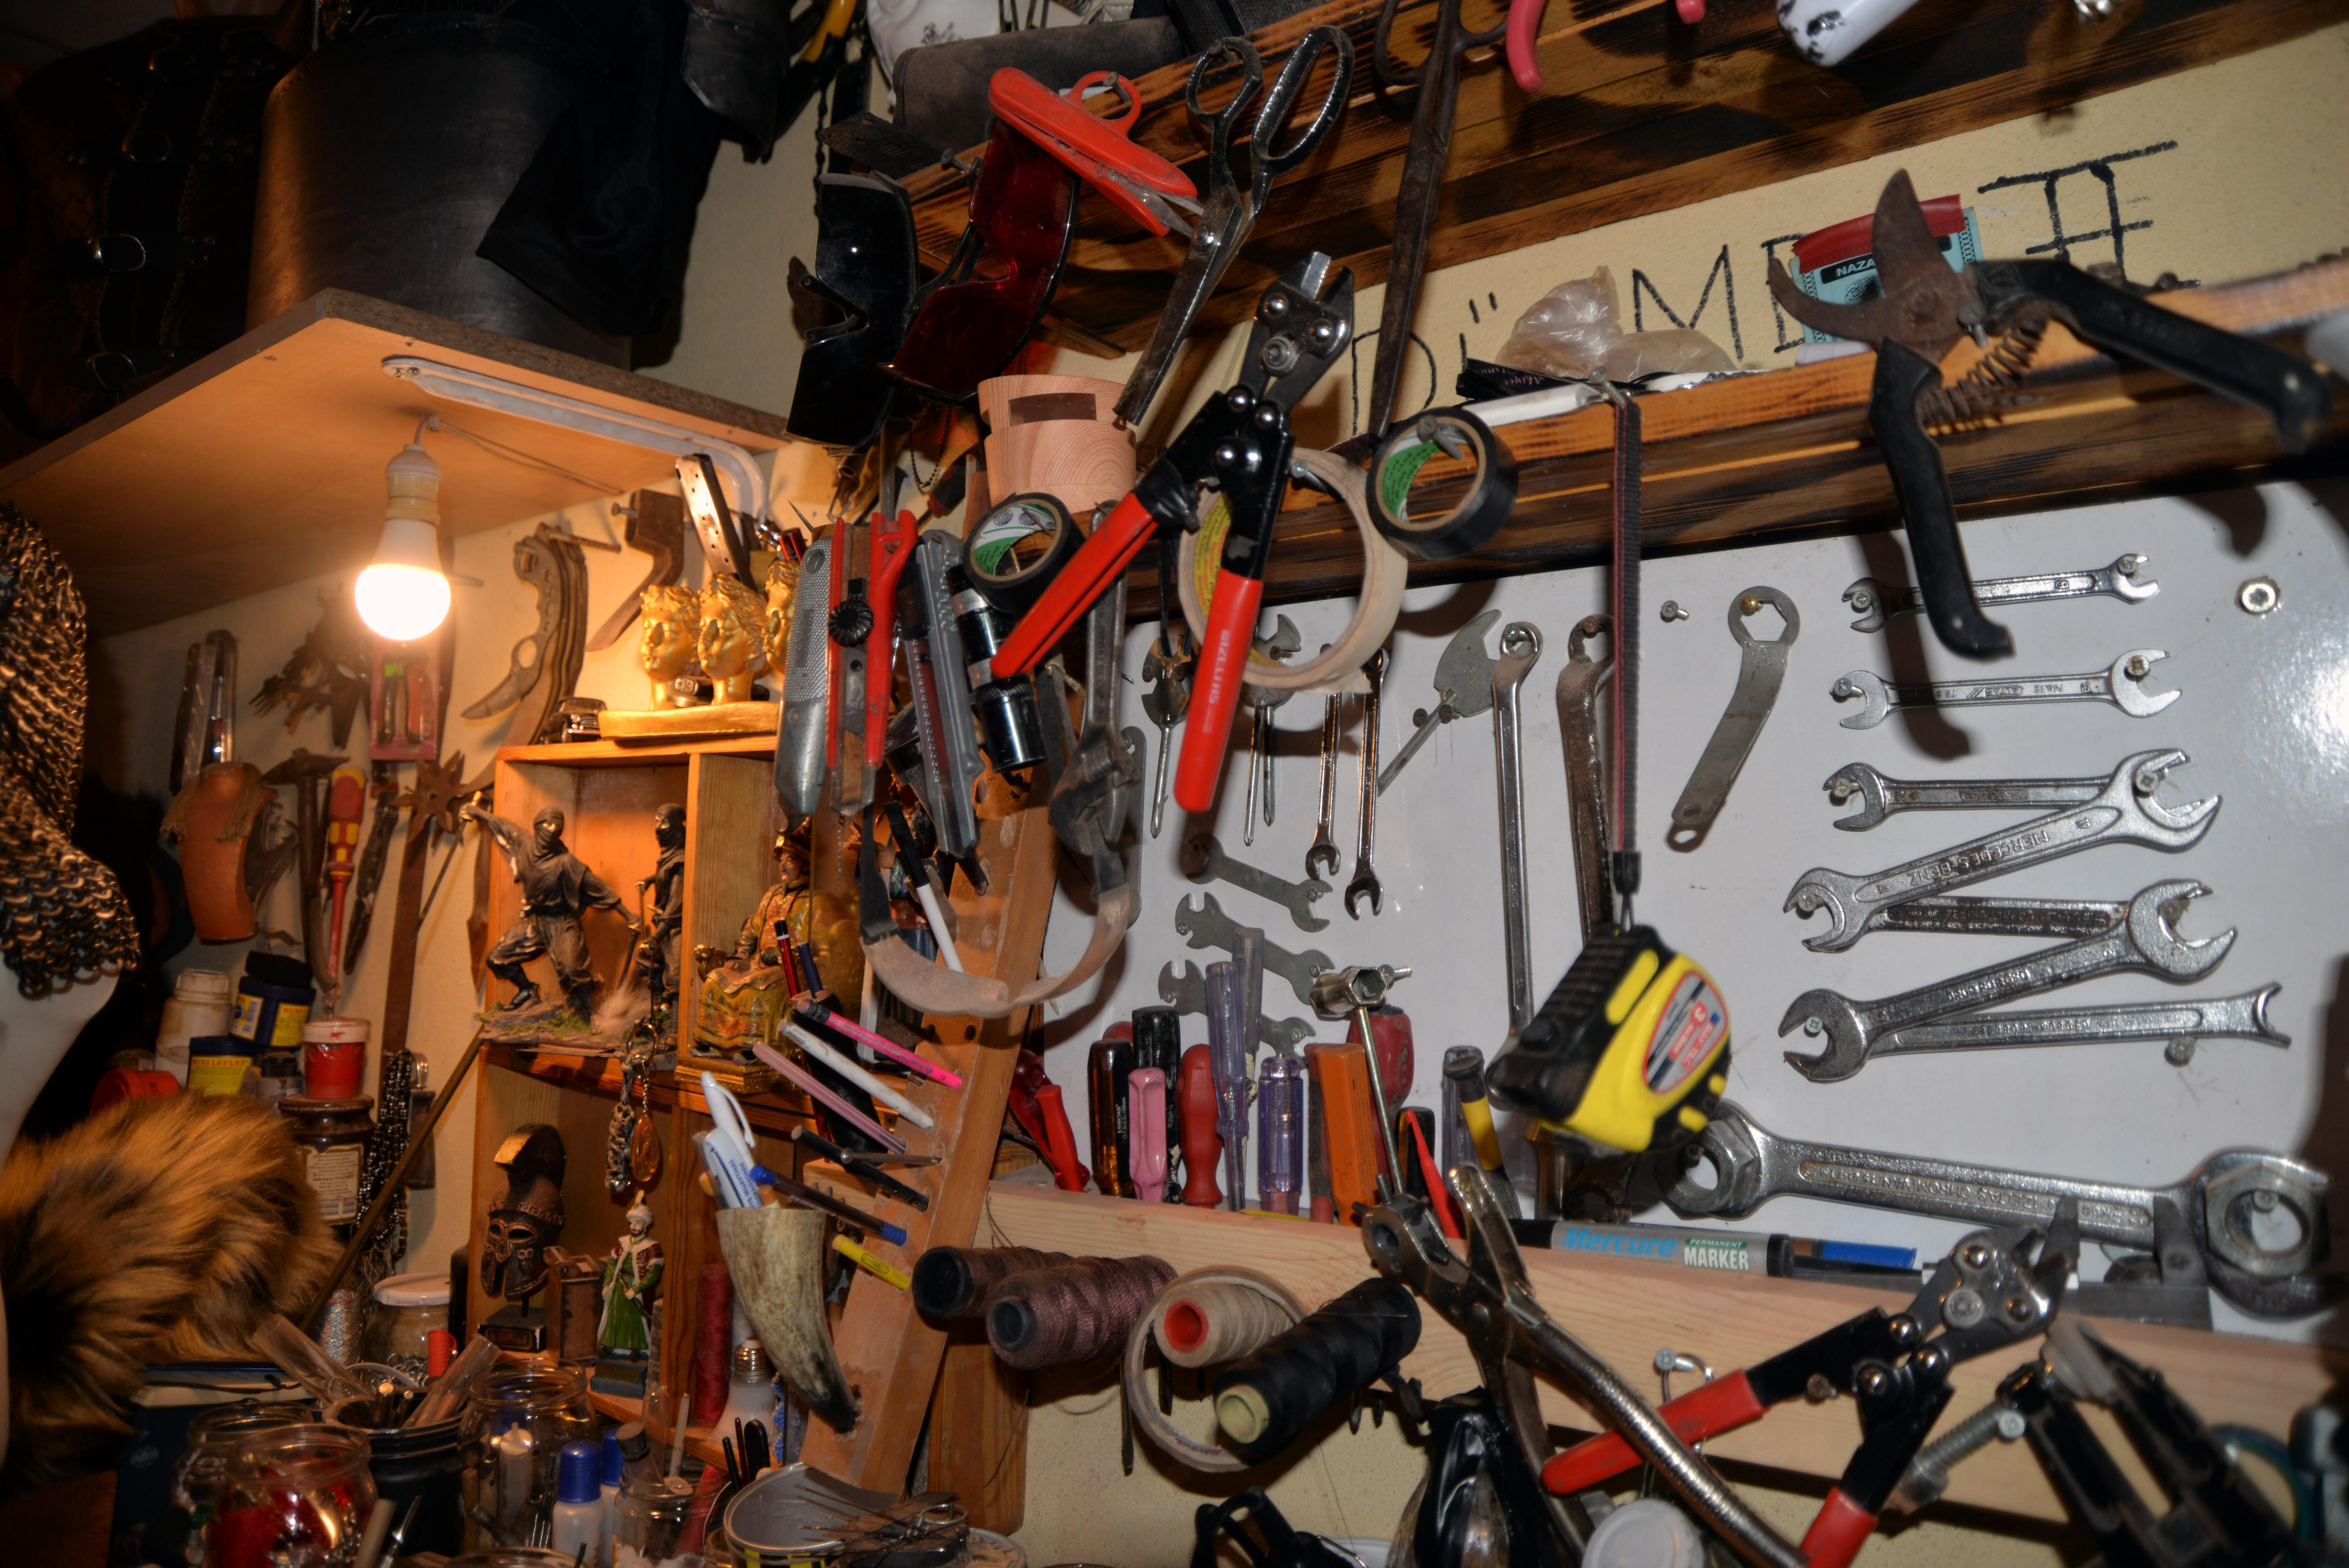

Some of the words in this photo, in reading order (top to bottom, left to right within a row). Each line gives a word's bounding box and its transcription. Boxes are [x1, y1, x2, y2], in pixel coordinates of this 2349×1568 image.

[1836, 259, 1876, 277] NAZA
[1908, 830, 2050, 886] MERCEDES-BENZ
[1562, 1226, 1677, 1258] Mercure
[1690, 1238, 1744, 1248] PERMANENT
[1684, 1246, 1750, 1271] MARKER
